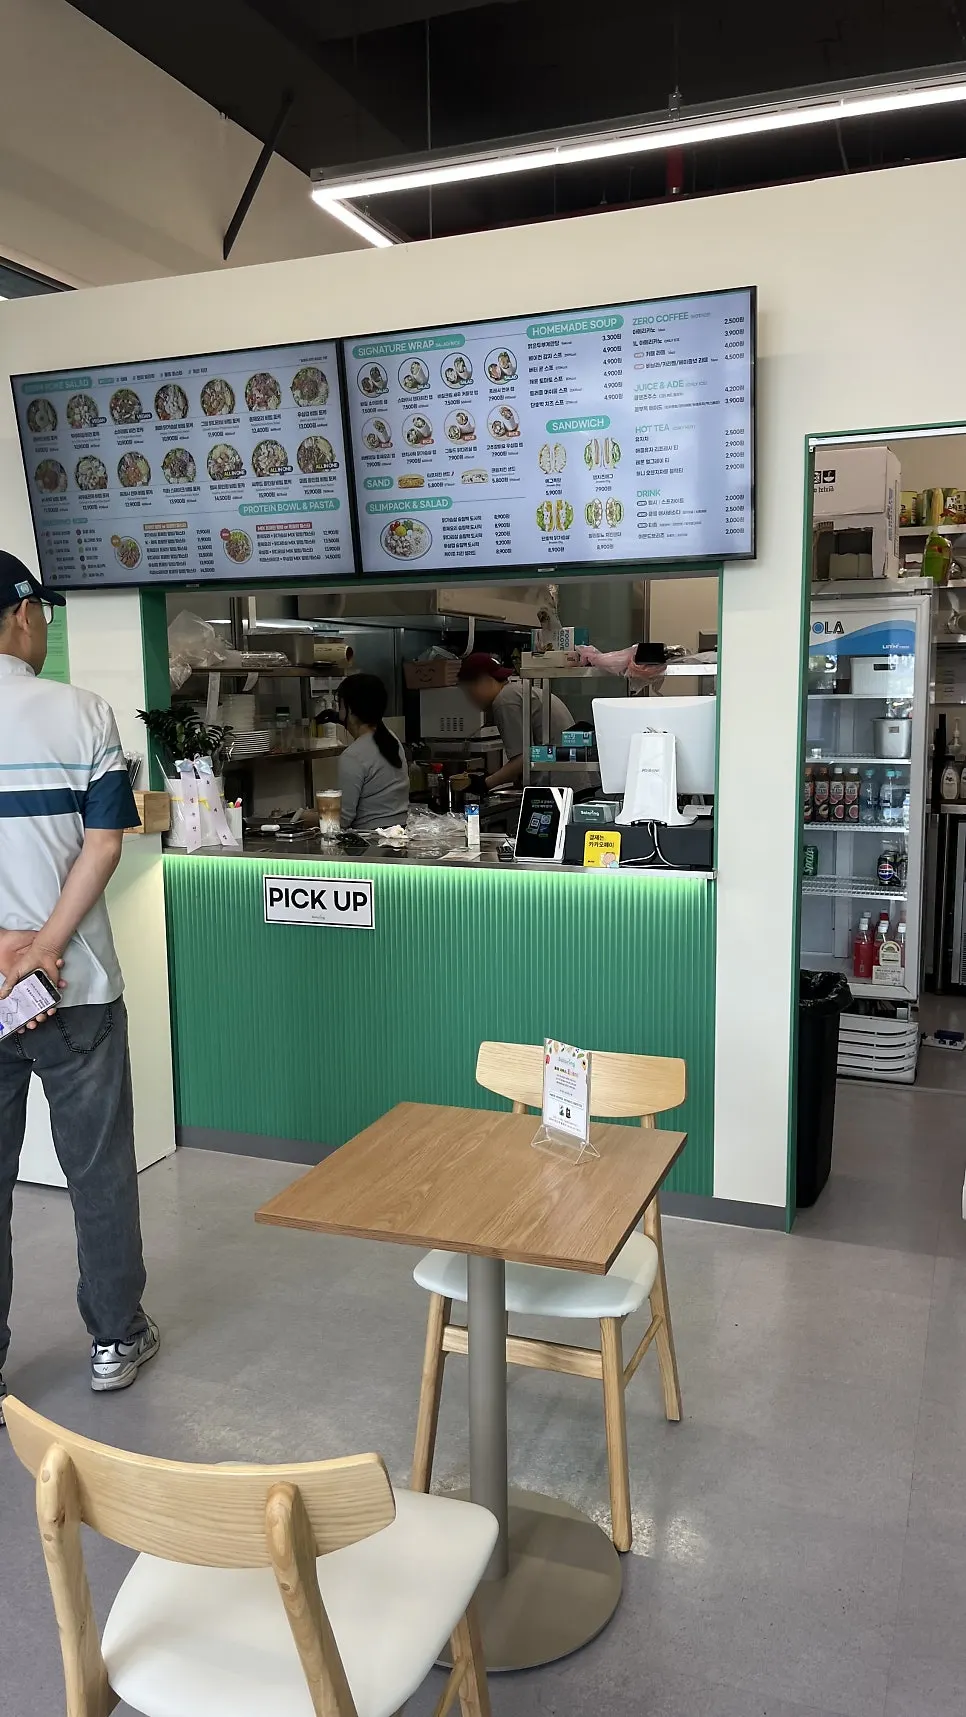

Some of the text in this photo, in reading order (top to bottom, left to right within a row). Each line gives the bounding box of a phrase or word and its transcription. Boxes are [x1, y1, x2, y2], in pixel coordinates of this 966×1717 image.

[632, 311, 688, 325] ZERO COFFEE
[532, 318, 616, 335] HOMEMADE SOUP
[358, 339, 434, 356] SIGNATURE WRAP
[64, 378, 89, 388] SALAD
[633, 379, 684, 392] JUICE & ADE
[552, 418, 604, 430] SANDWICH
[635, 422, 669, 433] HOT TEA
[367, 478, 391, 489] SAND
[636, 489, 660, 497] DRINK
[243, 504, 276, 513] PROTEIN
[278, 502, 300, 511] BOWL
[309, 500, 334, 508] PASTA
[369, 498, 449, 512] SLIMPACK & SALAD
[269, 887, 368, 912] PICK UP
